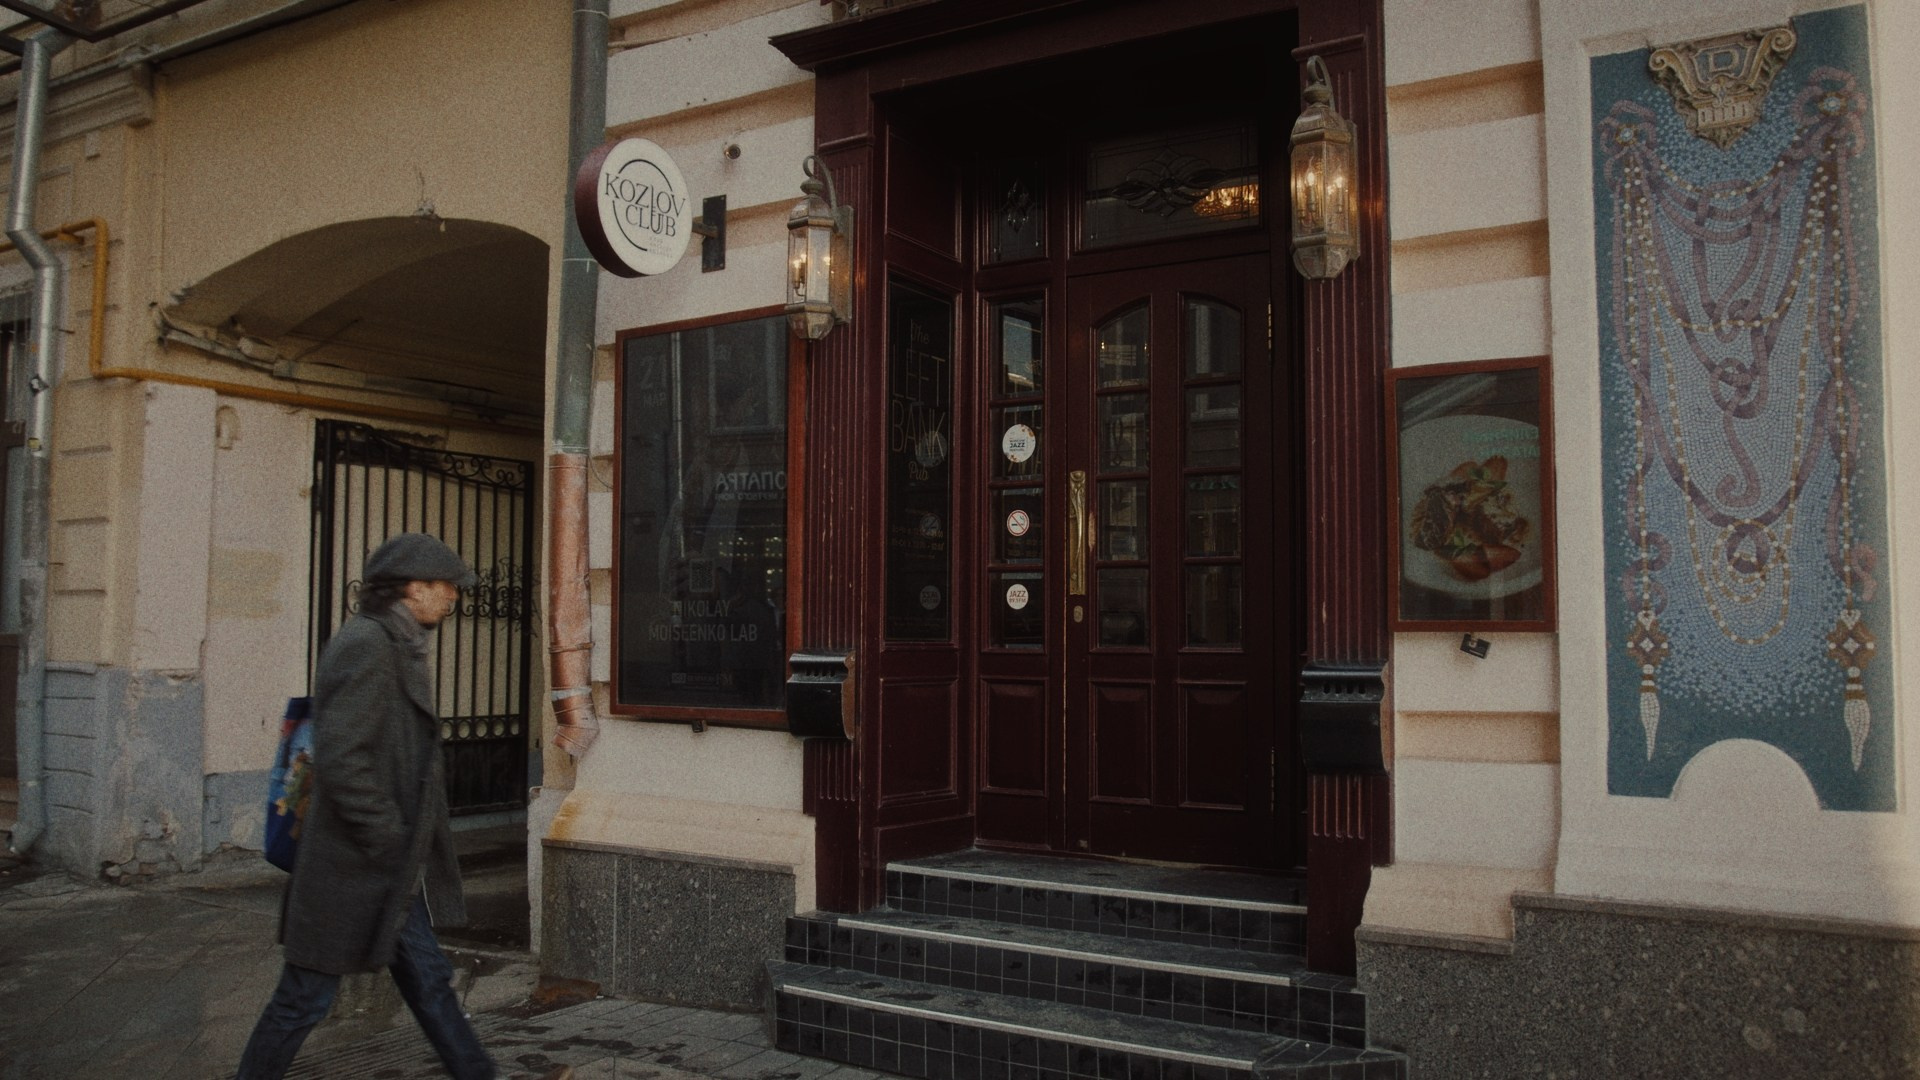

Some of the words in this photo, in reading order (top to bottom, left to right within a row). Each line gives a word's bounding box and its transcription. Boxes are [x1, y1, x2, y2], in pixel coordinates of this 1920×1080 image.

[605, 172, 686, 217] KOZLOV
[626, 204, 676, 237] CLUB
[911, 322, 930, 344] The
[640, 354, 667, 389] 21
[893, 344, 946, 407] LEFT
[892, 399, 946, 461] BANK
[908, 460, 929, 481] Pub
[673, 600, 731, 618] NIKOLAY
[648, 623, 726, 641] MOISEENKO
[730, 623, 757, 641] LAB
